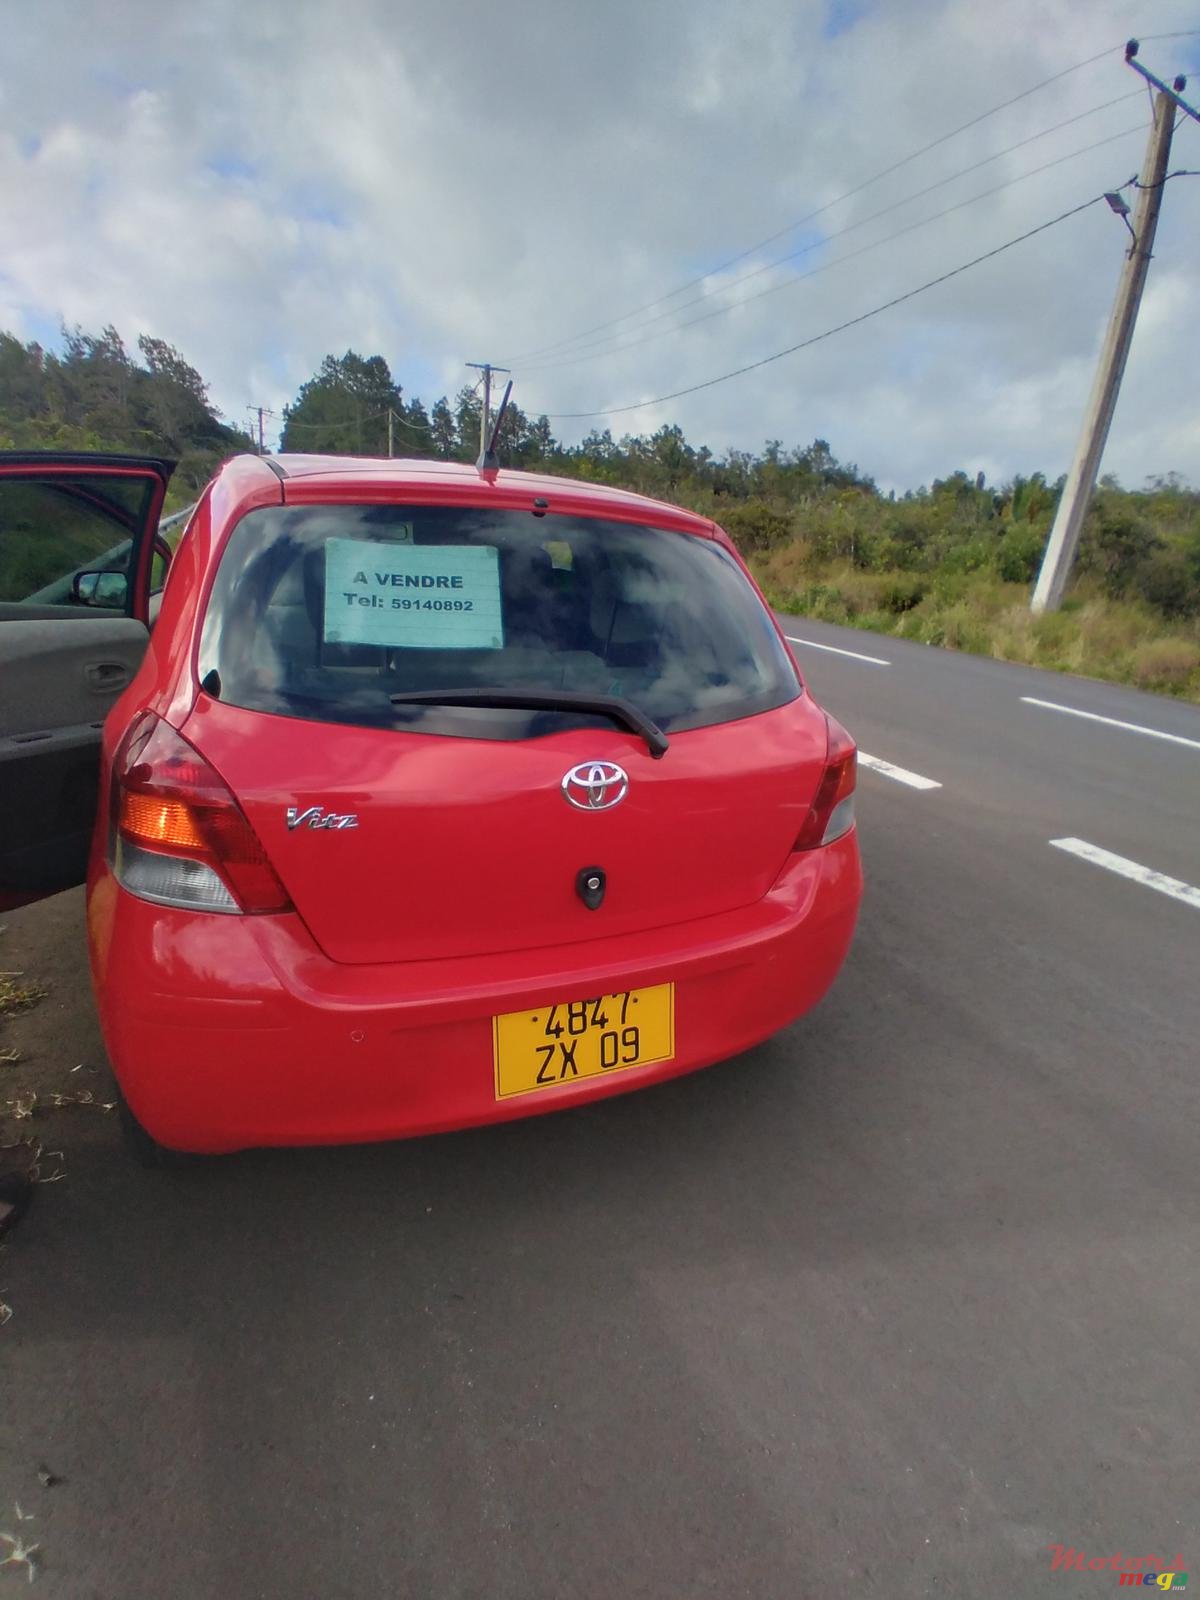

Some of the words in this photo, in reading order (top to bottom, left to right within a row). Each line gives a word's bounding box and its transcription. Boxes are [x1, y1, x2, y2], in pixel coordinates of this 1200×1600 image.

[353, 571, 368, 584] A
[374, 572, 463, 588] VENDRE
[343, 592, 384, 608] Tel:
[391, 598, 473, 611] 59140892
[287, 807, 358, 830] Vitz
[545, 991, 631, 1038] 4847
[535, 1039, 578, 1084] ZX
[600, 1026, 640, 1068] 09
